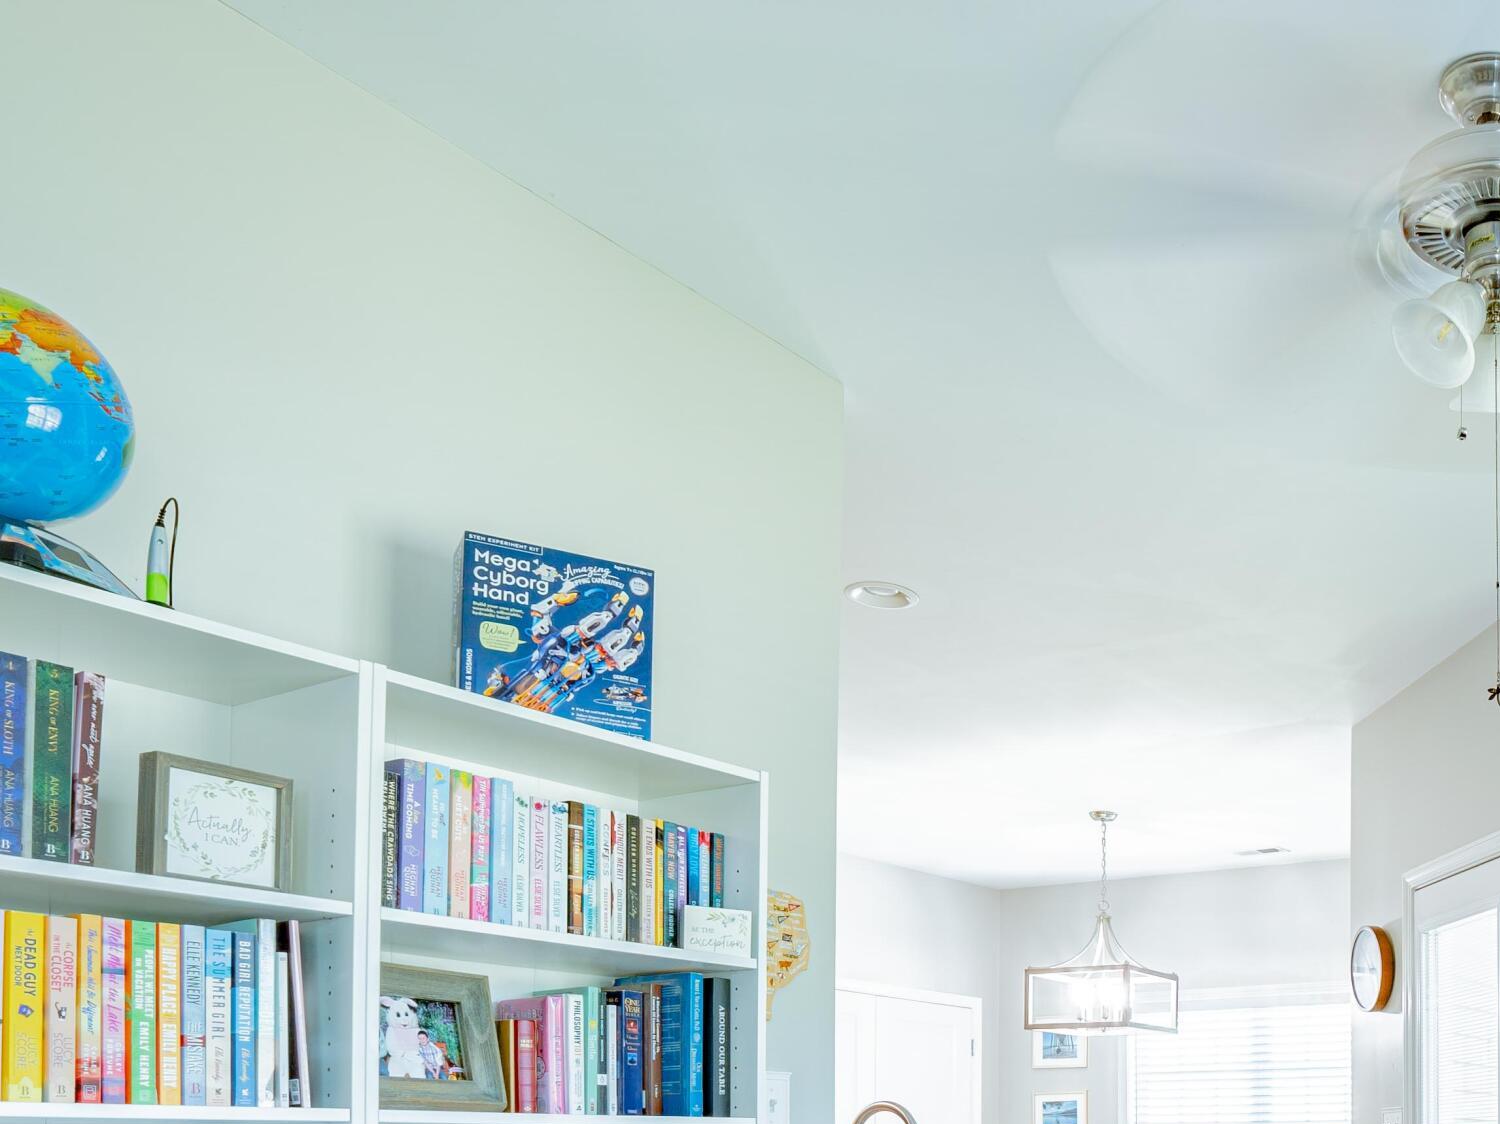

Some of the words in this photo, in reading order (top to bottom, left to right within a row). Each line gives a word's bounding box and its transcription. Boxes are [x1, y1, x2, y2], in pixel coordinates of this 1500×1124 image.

[468, 534, 486, 542] STEM
[487, 537, 528, 550] EXPERIMENT
[474, 549, 530, 572] Mega
[472, 582, 529, 605] Hand
[473, 566, 549, 596] Cyborg
[4, 770, 14, 790] ANA
[49, 776, 58, 796] ANA
[406, 783, 414, 802] TIME
[82, 784, 93, 806] ANA
[3, 793, 14, 827] HUANG
[48, 799, 58, 833] HUANG
[405, 804, 413, 839] COMING
[81, 809, 92, 845] HUANG
[188, 806, 252, 842] Actually
[587, 819, 595, 846] STARTS
[646, 826, 653, 834] IT
[386, 831, 394, 878] CRAWDADS
[534, 814, 544, 871] FLAWLESS
[667, 832, 675, 858] MAYBE
[690, 833, 698, 855] UGLY
[586, 849, 595, 869] WITH
[667, 861, 675, 880] NOW
[690, 856, 698, 877] LOVE
[404, 866, 412, 893] QUINN
[410, 864, 418, 896] MEGHAN
[535, 878, 543, 895] ELSIE
[586, 871, 594, 880] US
[646, 879, 652, 888] US
[534, 896, 542, 916] SILVER
[24, 938, 36, 969] DEAD
[187, 941, 201, 961] ELLE
[213, 938, 225, 956] THE
[239, 941, 251, 959] BAD
[690, 935, 746, 952] exception
[63, 950, 73, 988] CORPSE
[145, 949, 153, 979] PEOPLE
[239, 962, 250, 983] GIRL
[24, 972, 36, 996] GUY
[135, 969, 143, 1009] VACATION
[144, 981, 153, 994] WE
[187, 964, 201, 1006] KENNEDY
[212, 961, 226, 1008] SUMMER
[144, 995, 153, 1018] MEET
[239, 986, 251, 1042] REPUTATION
[211, 1012, 225, 1041] GIRL
[573, 1000, 581, 1044] PHILOSOPHY
[139, 1021, 149, 1051] EMILY
[16, 1032, 27, 1069] SCORE
[27, 1037, 36, 1066] LUCY
[52, 1032, 63, 1068] SCORE
[64, 1038, 73, 1065] LUCY
[139, 1054, 150, 1087] HENRY
